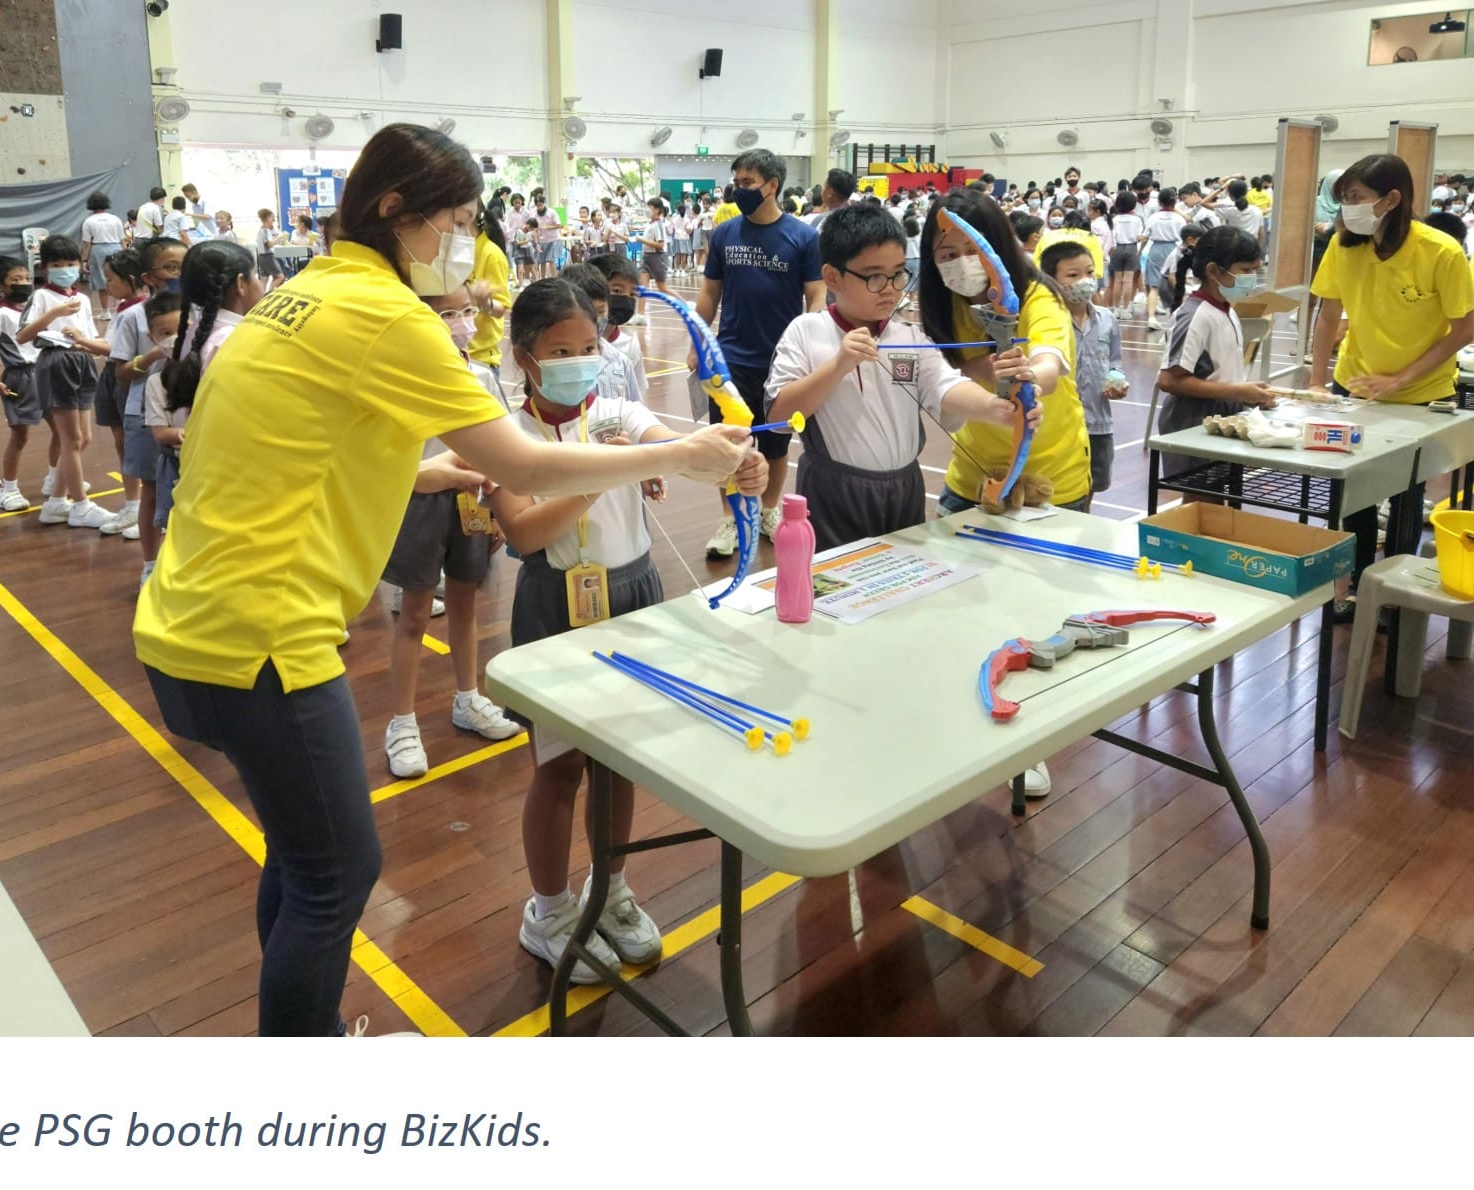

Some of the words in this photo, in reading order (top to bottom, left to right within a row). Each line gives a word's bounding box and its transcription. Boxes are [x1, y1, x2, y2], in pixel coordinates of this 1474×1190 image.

[725, 245, 764, 254] PHYSICAL
[725, 251, 767, 260] Education
[772, 254, 780, 263] &
[725, 258, 752, 267] SPORTS
[752, 259, 789, 271] SCIENCE
[1251, 559, 1289, 578] PAPER
